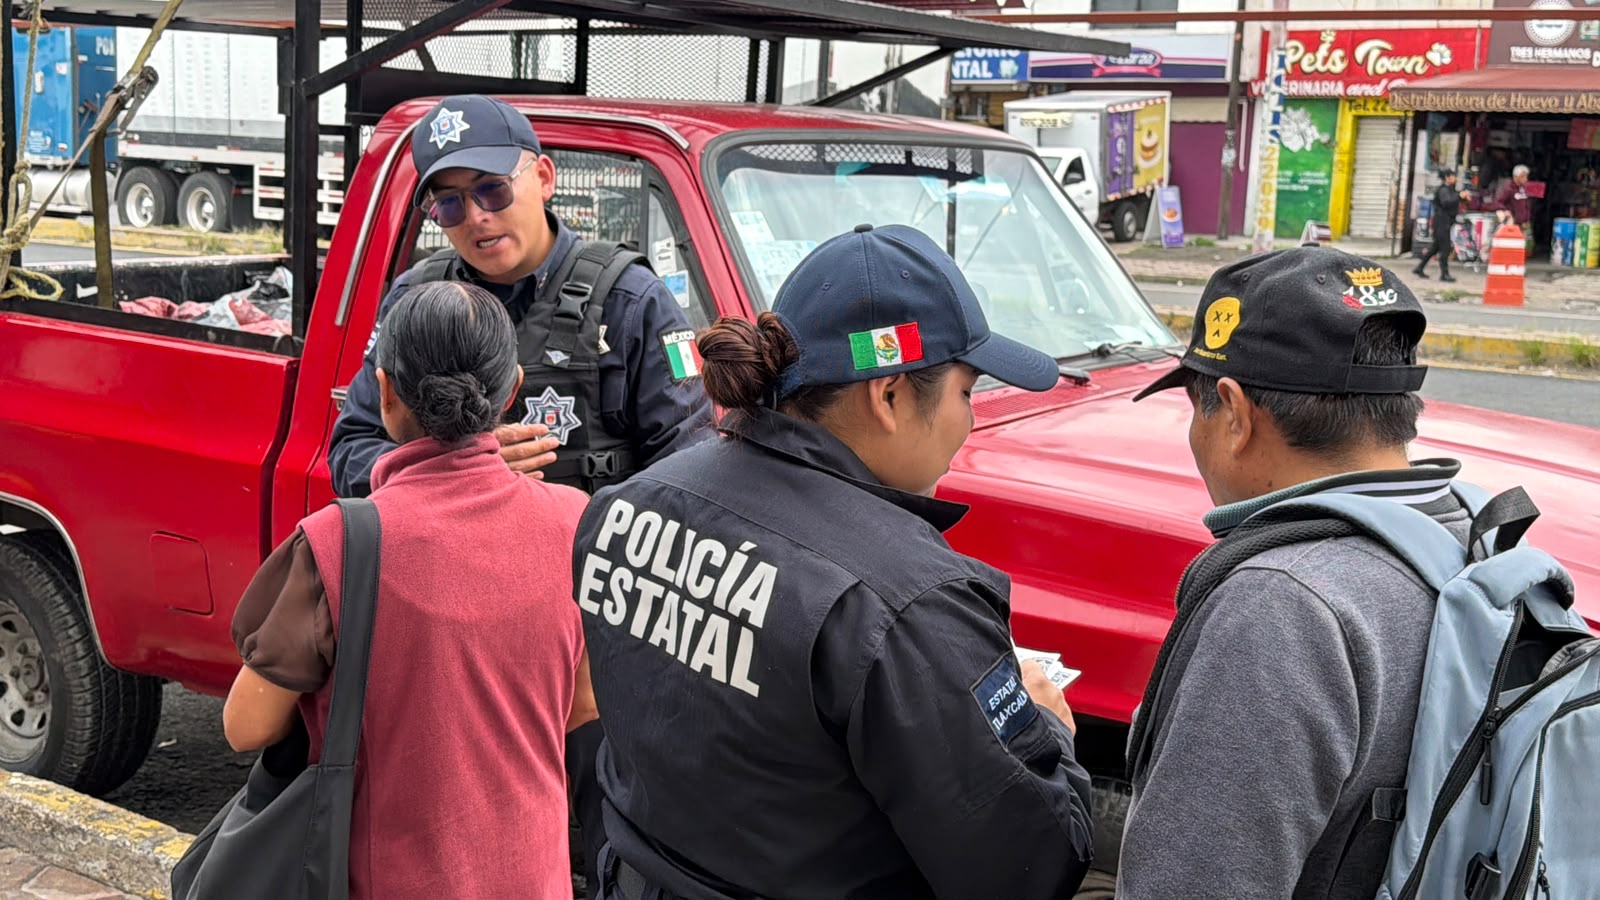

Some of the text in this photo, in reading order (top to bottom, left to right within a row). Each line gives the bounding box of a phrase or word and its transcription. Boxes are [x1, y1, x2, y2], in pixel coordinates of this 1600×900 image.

[1284, 39, 1429, 77] Pets Town
[1509, 46, 1591, 60] TRES HERMANOS
[1347, 79, 1384, 97] and
[1487, 93, 1507, 109] de
[1510, 93, 1558, 110] Huevo
[1563, 95, 1574, 111] y
[595, 499, 778, 629] POLICÍA
[578, 553, 760, 698] ESTATAL
